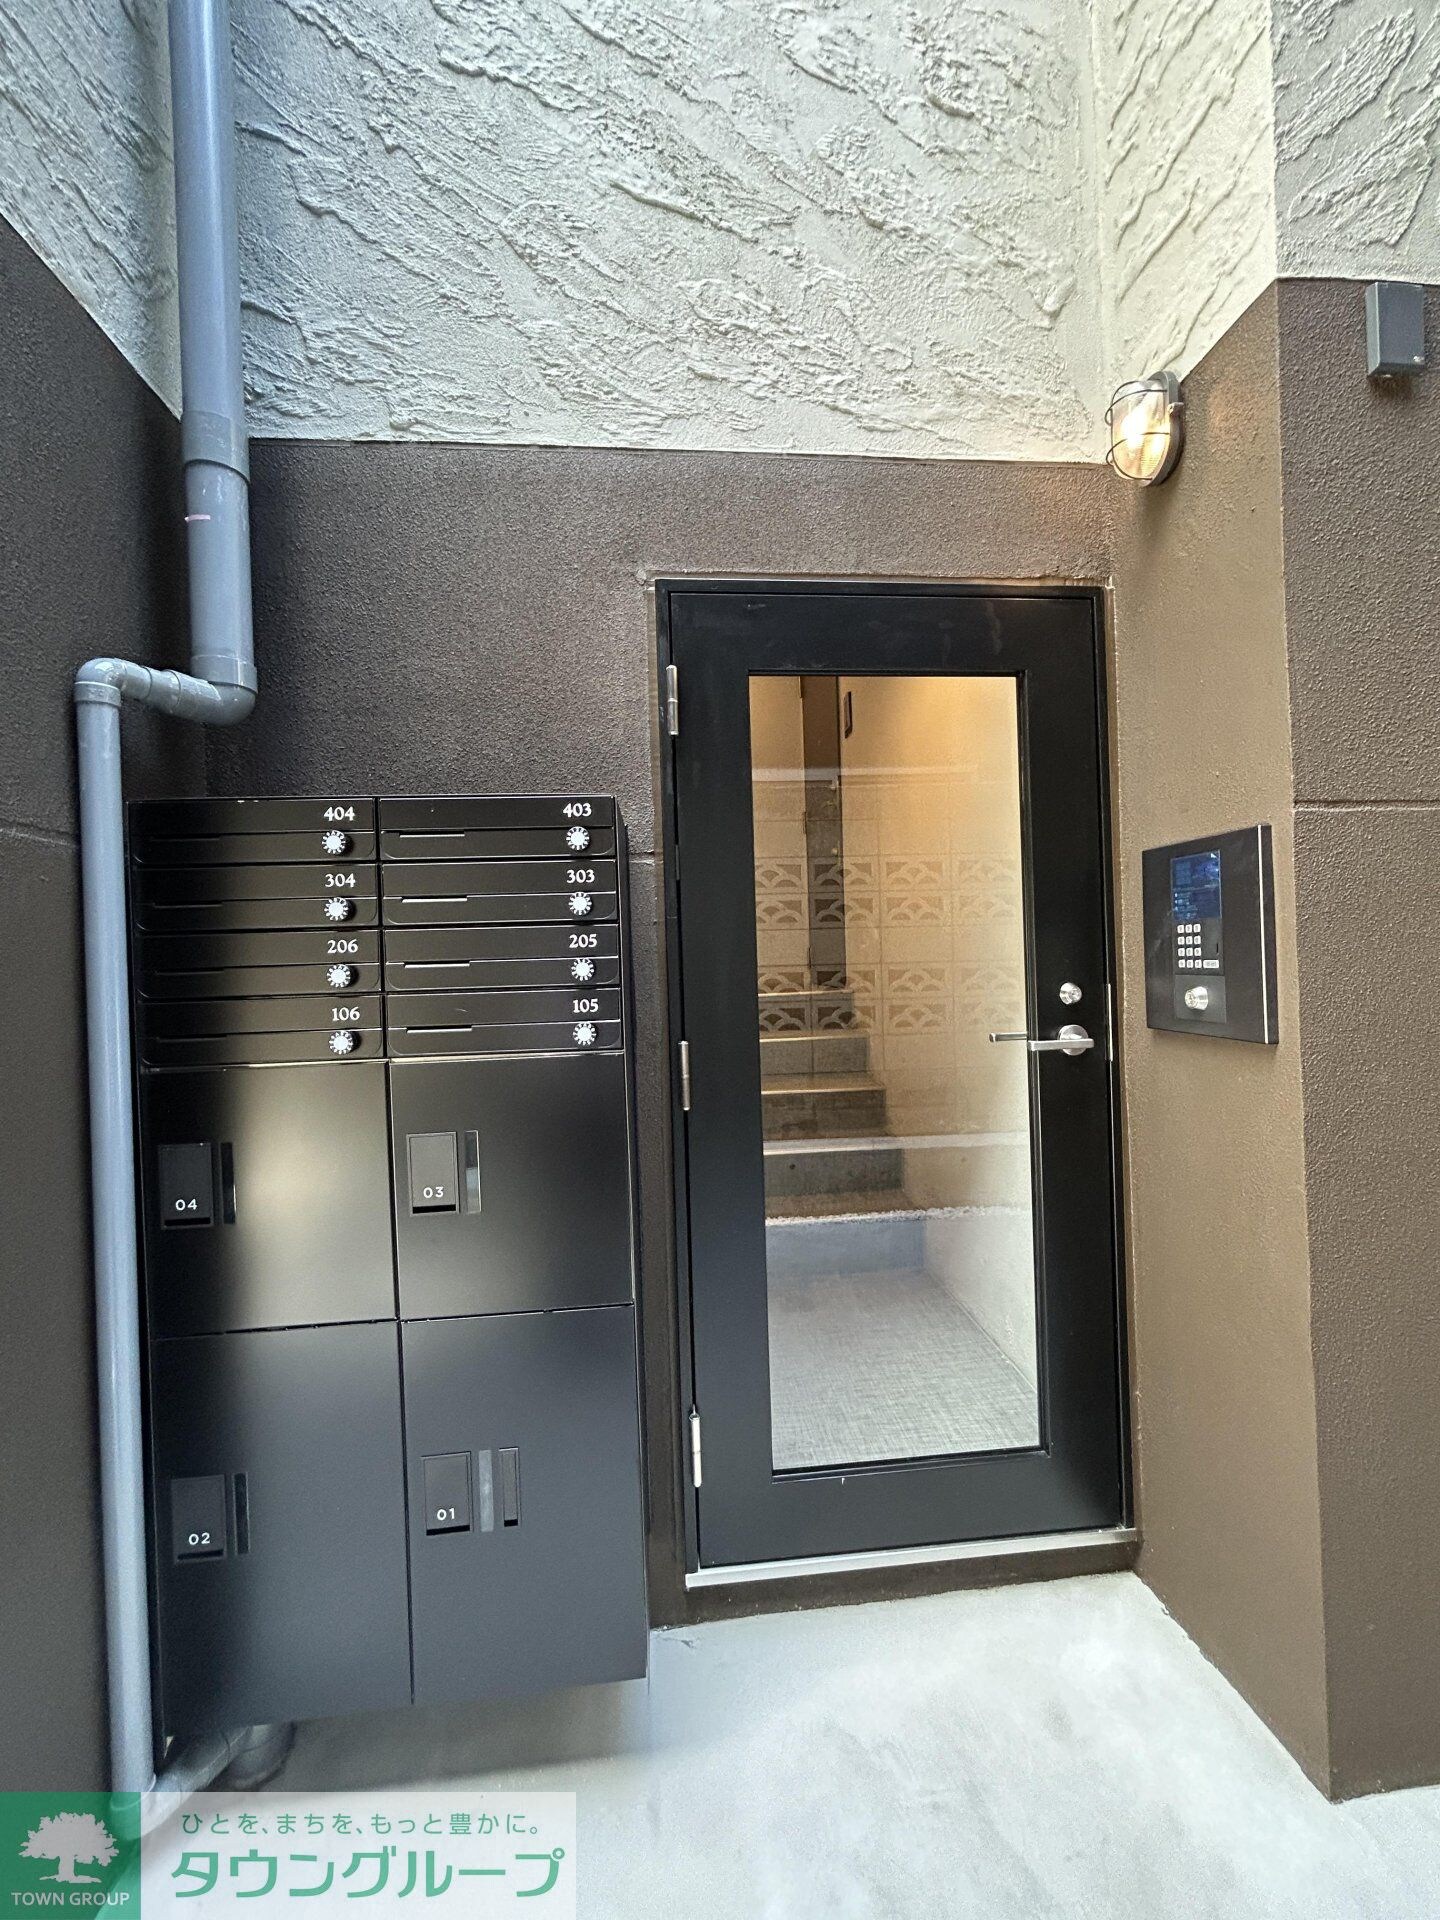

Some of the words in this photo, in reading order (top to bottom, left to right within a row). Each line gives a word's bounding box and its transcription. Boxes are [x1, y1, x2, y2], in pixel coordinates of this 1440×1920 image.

[323, 806, 356, 822] 404
[562, 802, 592, 818] 403
[324, 872, 356, 888] 304
[566, 869, 595, 884] 303
[327, 938, 359, 954] 206
[568, 933, 598, 949] 205
[331, 1006, 361, 1022] 106
[572, 998, 599, 1014] 105
[423, 1186, 444, 1199] 03
[175, 1198, 198, 1211] 04
[436, 1507, 455, 1521] 01
[188, 1532, 211, 1546] 02
